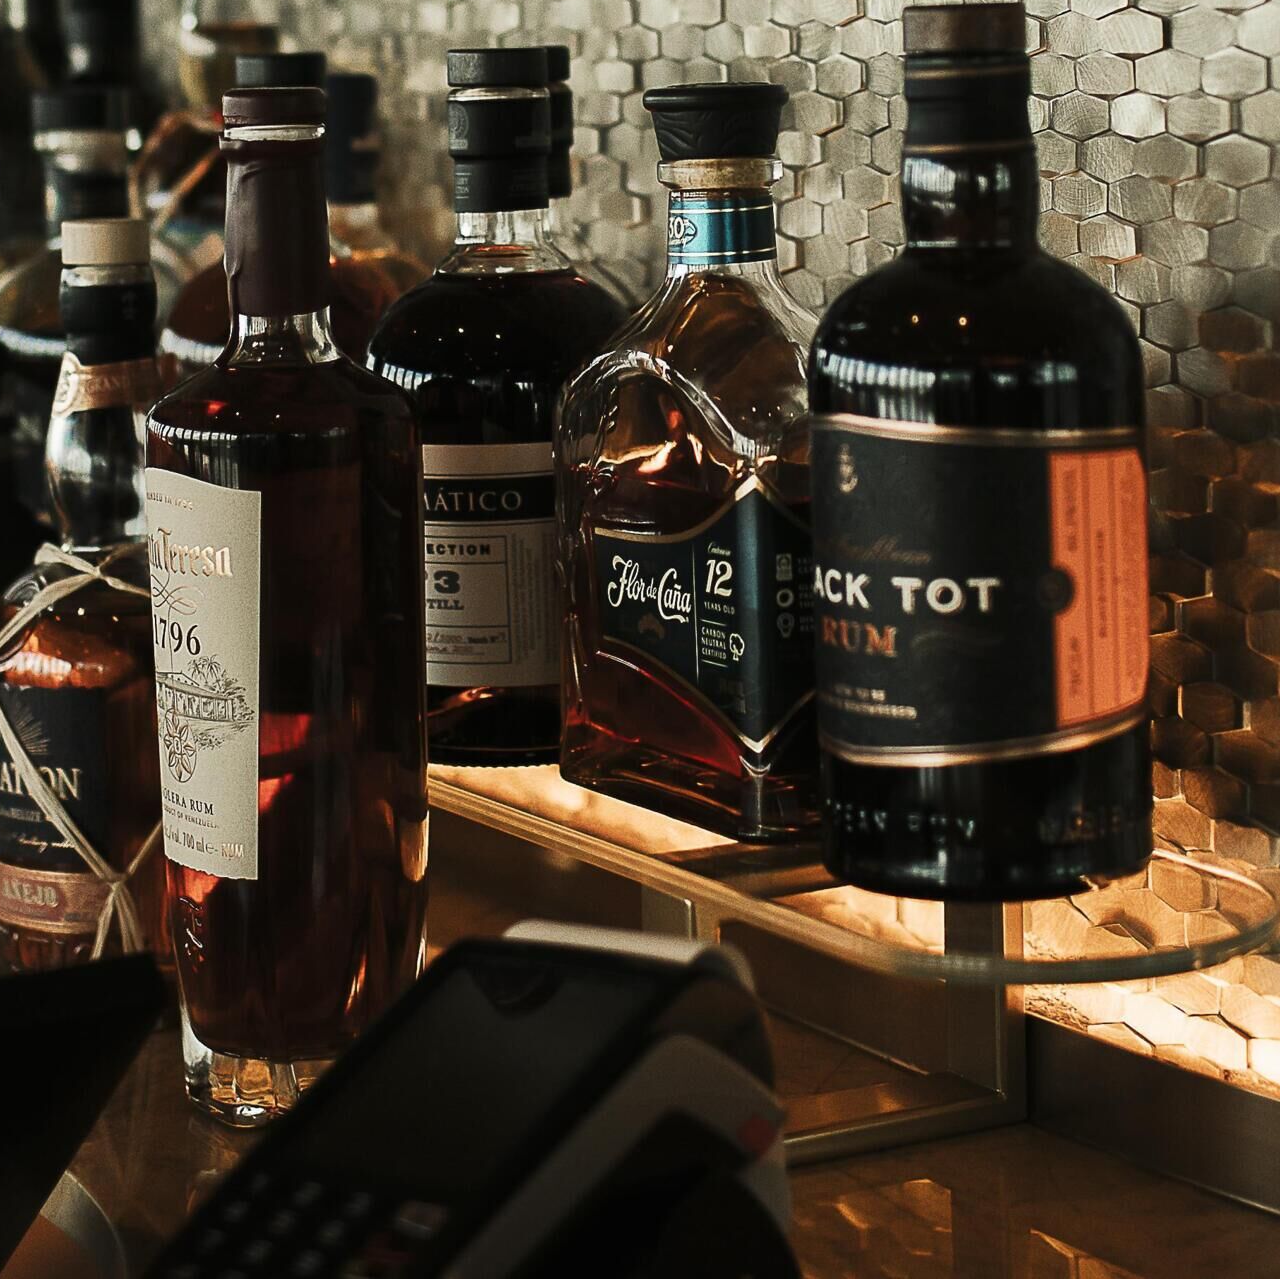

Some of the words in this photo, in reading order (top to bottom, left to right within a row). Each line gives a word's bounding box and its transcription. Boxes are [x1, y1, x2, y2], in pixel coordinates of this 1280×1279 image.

[158, 526, 233, 577] Teresa
[426, 543, 490, 556] ECTION
[607, 555, 646, 607] Flor
[646, 577, 658, 599] de
[657, 567, 692, 623] Caña
[705, 559, 733, 597] 12
[890, 576, 1001, 614] TOT
[704, 601, 722, 613] YEARS
[723, 605, 736, 616] OLD
[154, 614, 201, 656] 1796
[701, 626, 726, 639] CARBON
[701, 636, 727, 650] NEUTRAL
[822, 616, 897, 657] RUM
[190, 798, 214, 816] RUM
